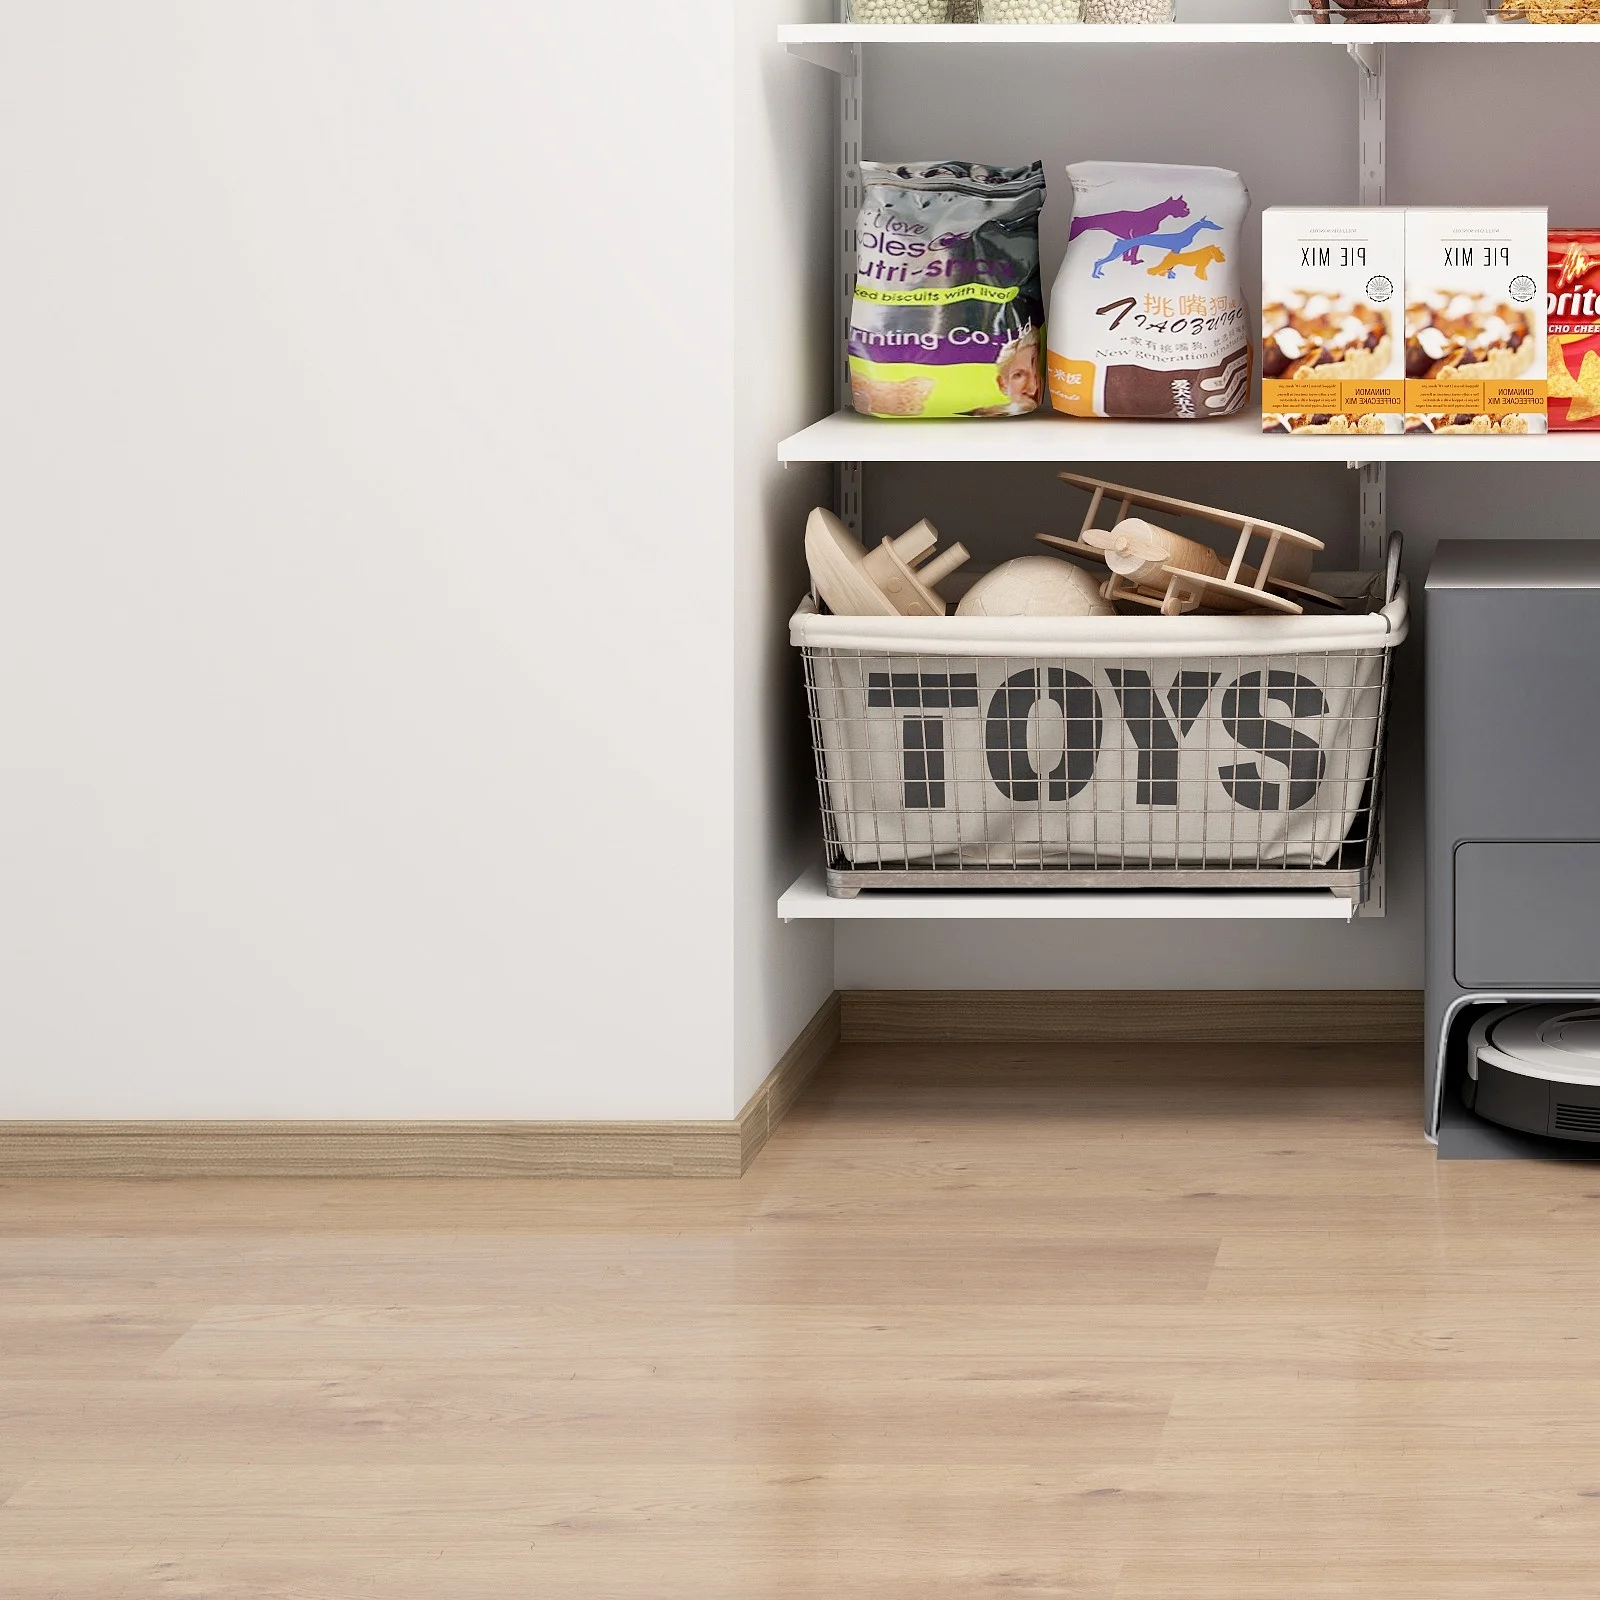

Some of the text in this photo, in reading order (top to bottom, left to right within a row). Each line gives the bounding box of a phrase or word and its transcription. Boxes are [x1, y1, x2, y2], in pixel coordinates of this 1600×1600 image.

[859, 232, 926, 258] oles
[882, 289, 940, 301] biscuits
[945, 286, 975, 300] with
[1548, 324, 1571, 333] CHO
[851, 329, 939, 350] rinting
[867, 667, 1330, 811] TOYS
